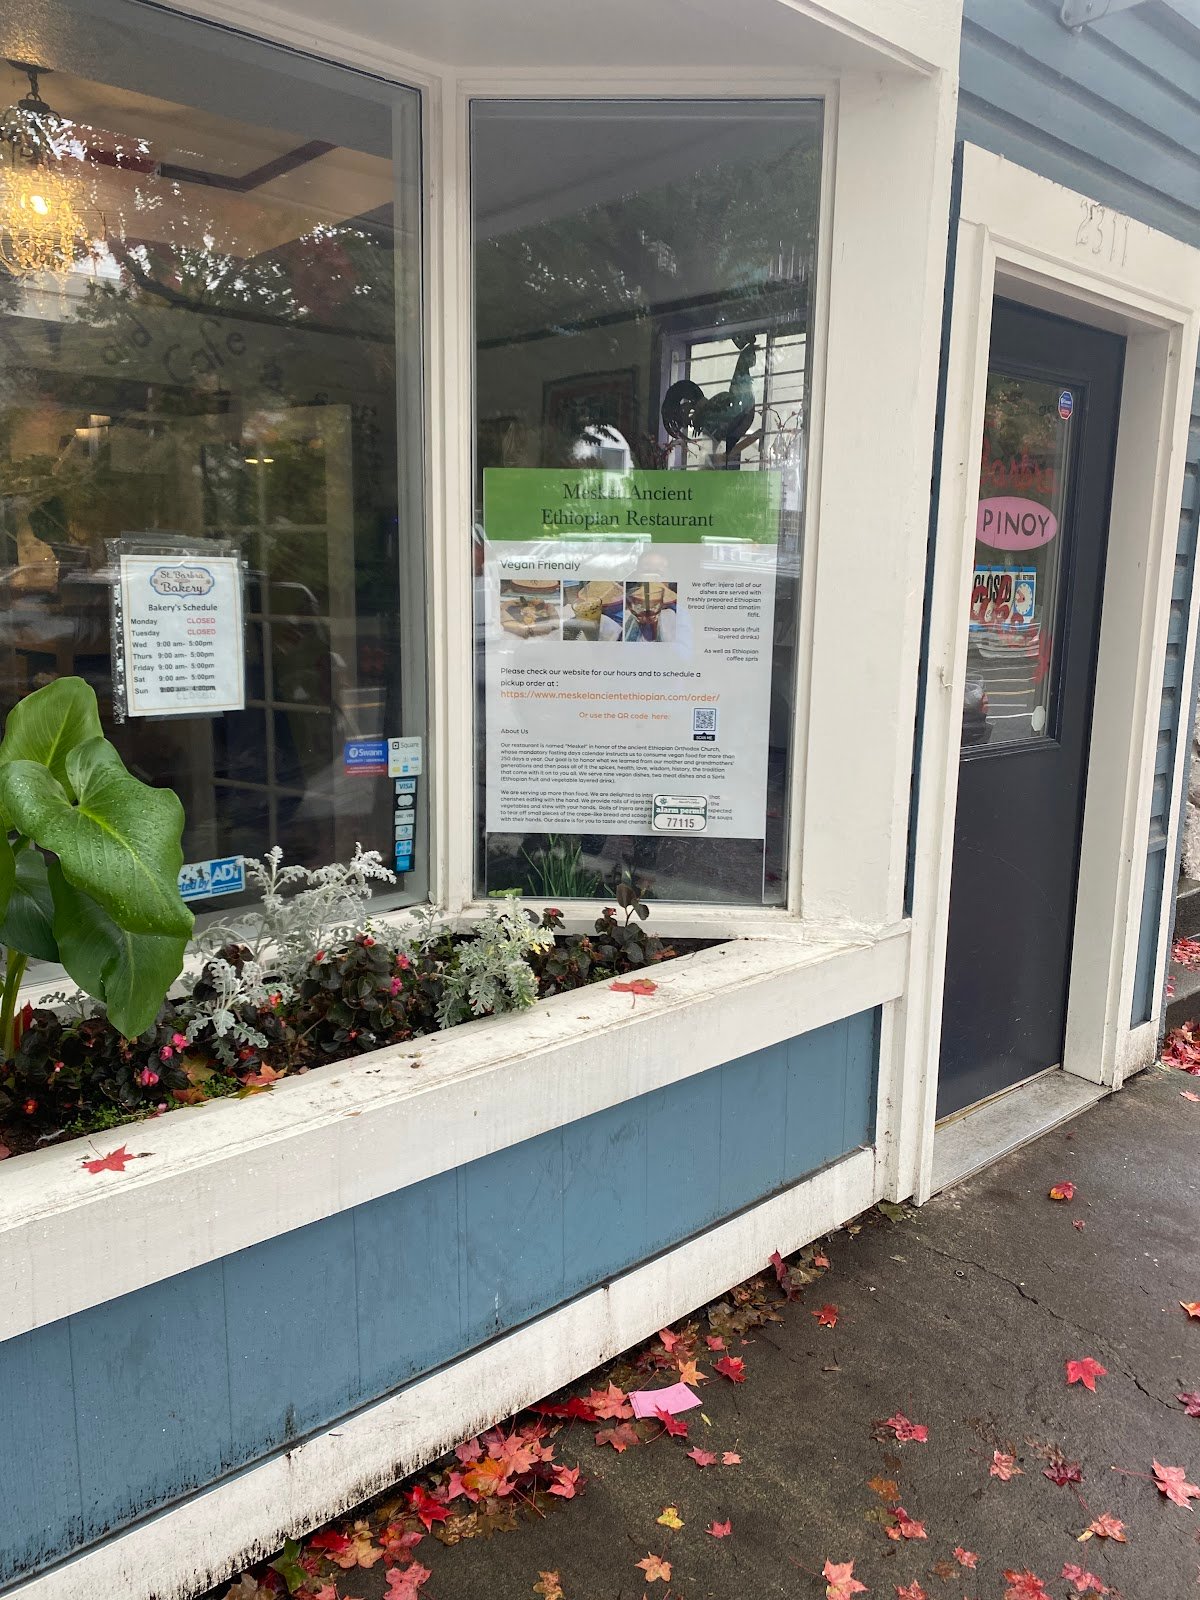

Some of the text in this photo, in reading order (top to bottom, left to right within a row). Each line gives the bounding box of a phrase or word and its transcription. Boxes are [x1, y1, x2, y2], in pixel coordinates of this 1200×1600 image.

[630, 485, 693, 500] Ancient
[542, 509, 714, 530] Ethiopian Restaurant
[983, 509, 1049, 537] PINOY
[500, 560, 580, 572] Vegan Friendly
[160, 581, 203, 594] Bakery
[974, 574, 1012, 603] CLOSD
[148, 603, 181, 612] Bakery's
[130, 618, 158, 626] Monday
[131, 630, 160, 638] Tuesday
[188, 640, 213, 648] 5:00pm
[190, 651, 215, 659] 5:00pm
[133, 664, 155, 672] Friday
[191, 662, 215, 670] 5:00pm
[191, 674, 215, 682] 5:00pm
[500, 690, 720, 702] https://www.meskelancientethiopian.com/order/
[579, 711, 588, 719] Or
[358, 748, 383, 757] Swann
[680, 807, 705, 815] permit
[666, 817, 695, 828] 77115
[211, 863, 239, 882] ADT
[197, 879, 209, 890] by
